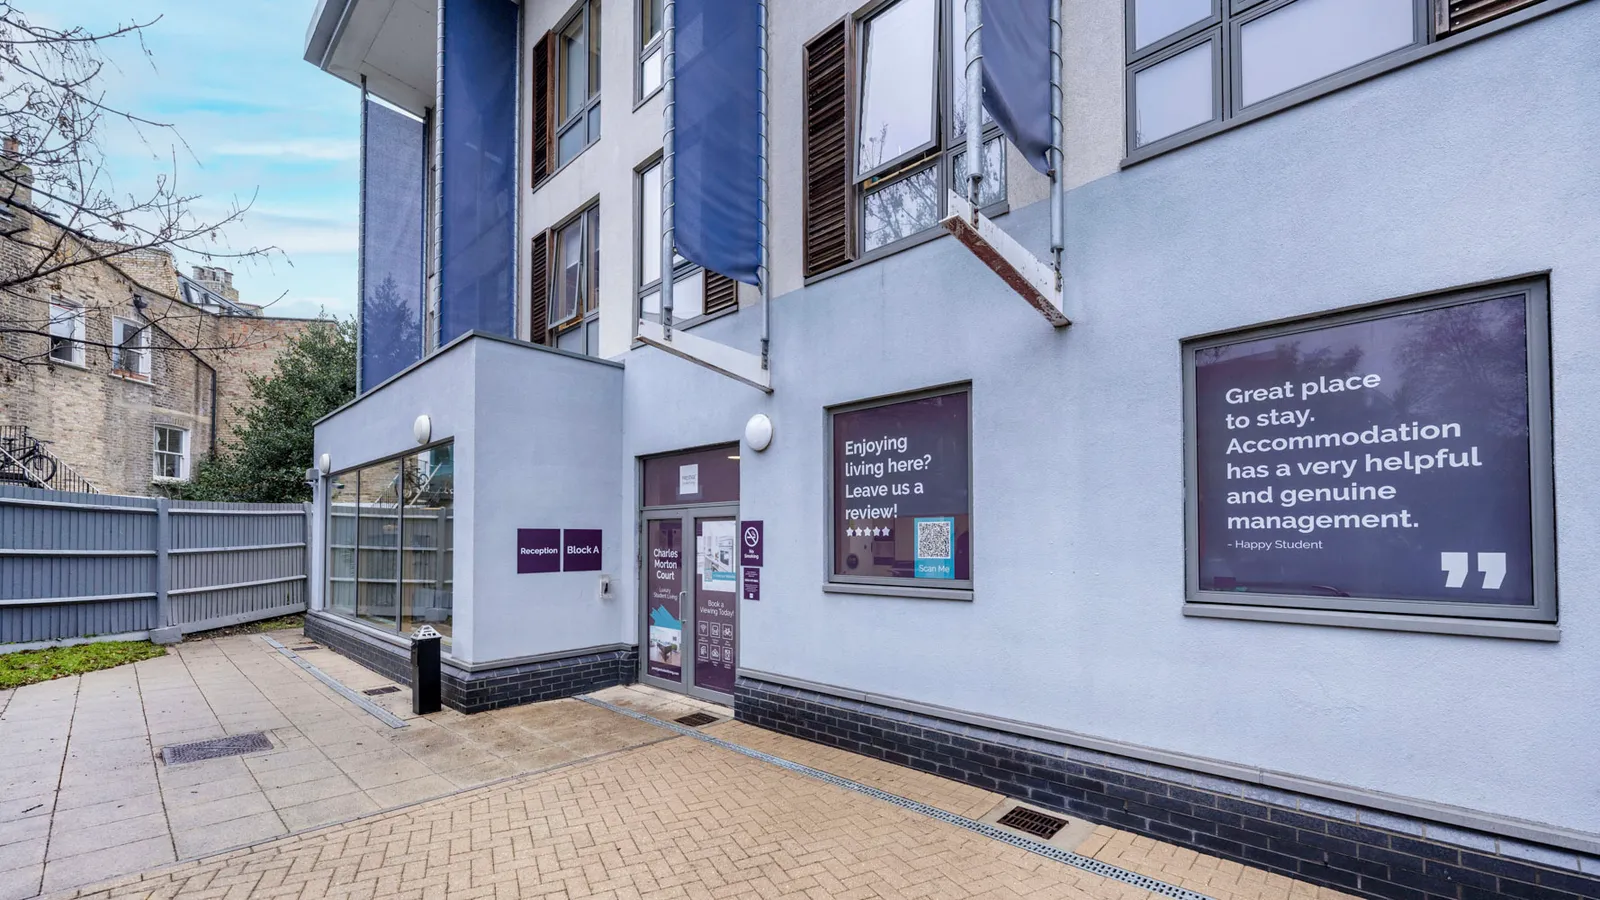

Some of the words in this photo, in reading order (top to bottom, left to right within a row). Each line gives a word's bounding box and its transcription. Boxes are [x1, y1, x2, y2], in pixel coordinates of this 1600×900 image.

[1225, 381, 1294, 404] Great
[1301, 373, 1381, 400] place
[1226, 413, 1250, 430] to
[1256, 408, 1315, 428] stay.
[845, 436, 907, 457] Enjoying
[1226, 421, 1461, 455] Accommodation
[845, 461, 884, 478] living
[888, 454, 932, 473] here?
[1227, 463, 1269, 479] has
[1275, 463, 1291, 477] a
[1297, 459, 1357, 479] very
[1365, 446, 1482, 475] helpful
[845, 484, 888, 499] Leave
[892, 482, 910, 496] us
[914, 482, 924, 494] a
[1226, 486, 1273, 504] and
[1280, 482, 1397, 507] genuine
[845, 503, 898, 520] review!
[1227, 510, 1419, 533] management.
[520, 547, 558, 556] Reception
[567, 545, 592, 554] Block
[593, 546, 600, 554] A
[653, 548, 678, 558] Charles
[1235, 540, 1272, 551] Happy
[1275, 540, 1323, 550] Student
[654, 559, 677, 569] Morton
[918, 564, 936, 573] Scan
[938, 564, 950, 573] Me
[656, 570, 675, 580] Court
[699, 606, 718, 616] Viewing
[719, 608, 734, 618] Today!
[707, 599, 720, 608] Book
